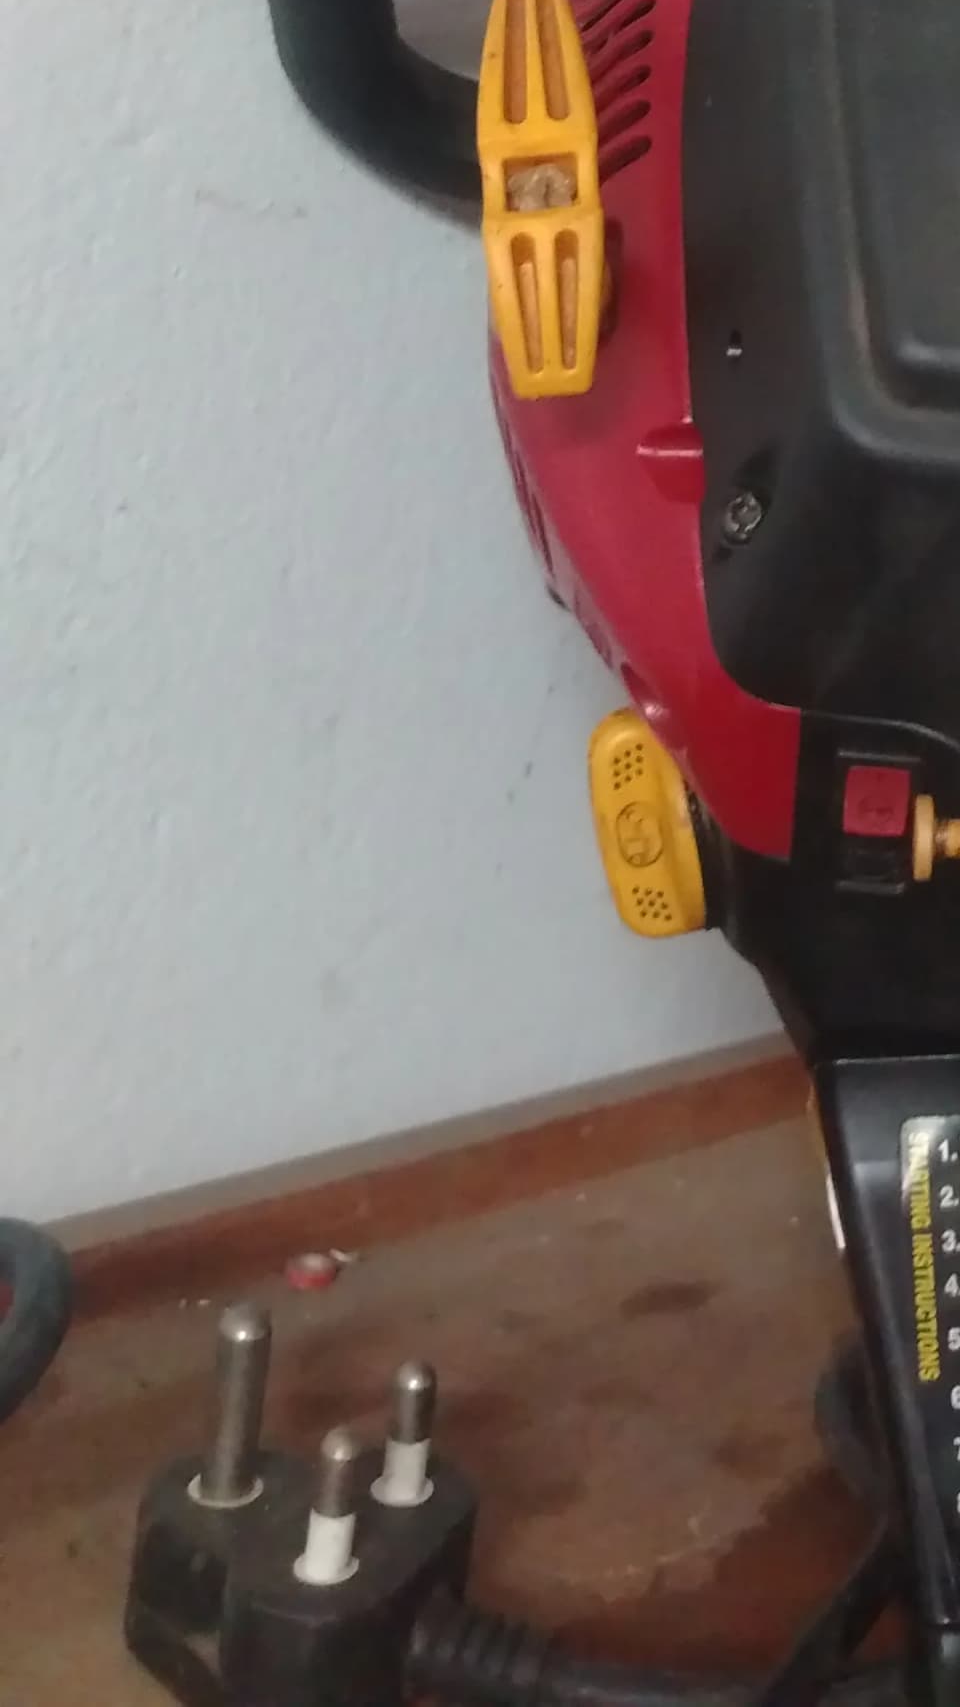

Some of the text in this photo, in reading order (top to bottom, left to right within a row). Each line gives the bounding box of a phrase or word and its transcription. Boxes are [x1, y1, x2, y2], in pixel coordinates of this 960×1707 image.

[938, 1138, 958, 1162] 1.
[939, 1185, 959, 1208] 2.
[908, 1131, 941, 1382] STARTING INSTRUCTIONS
